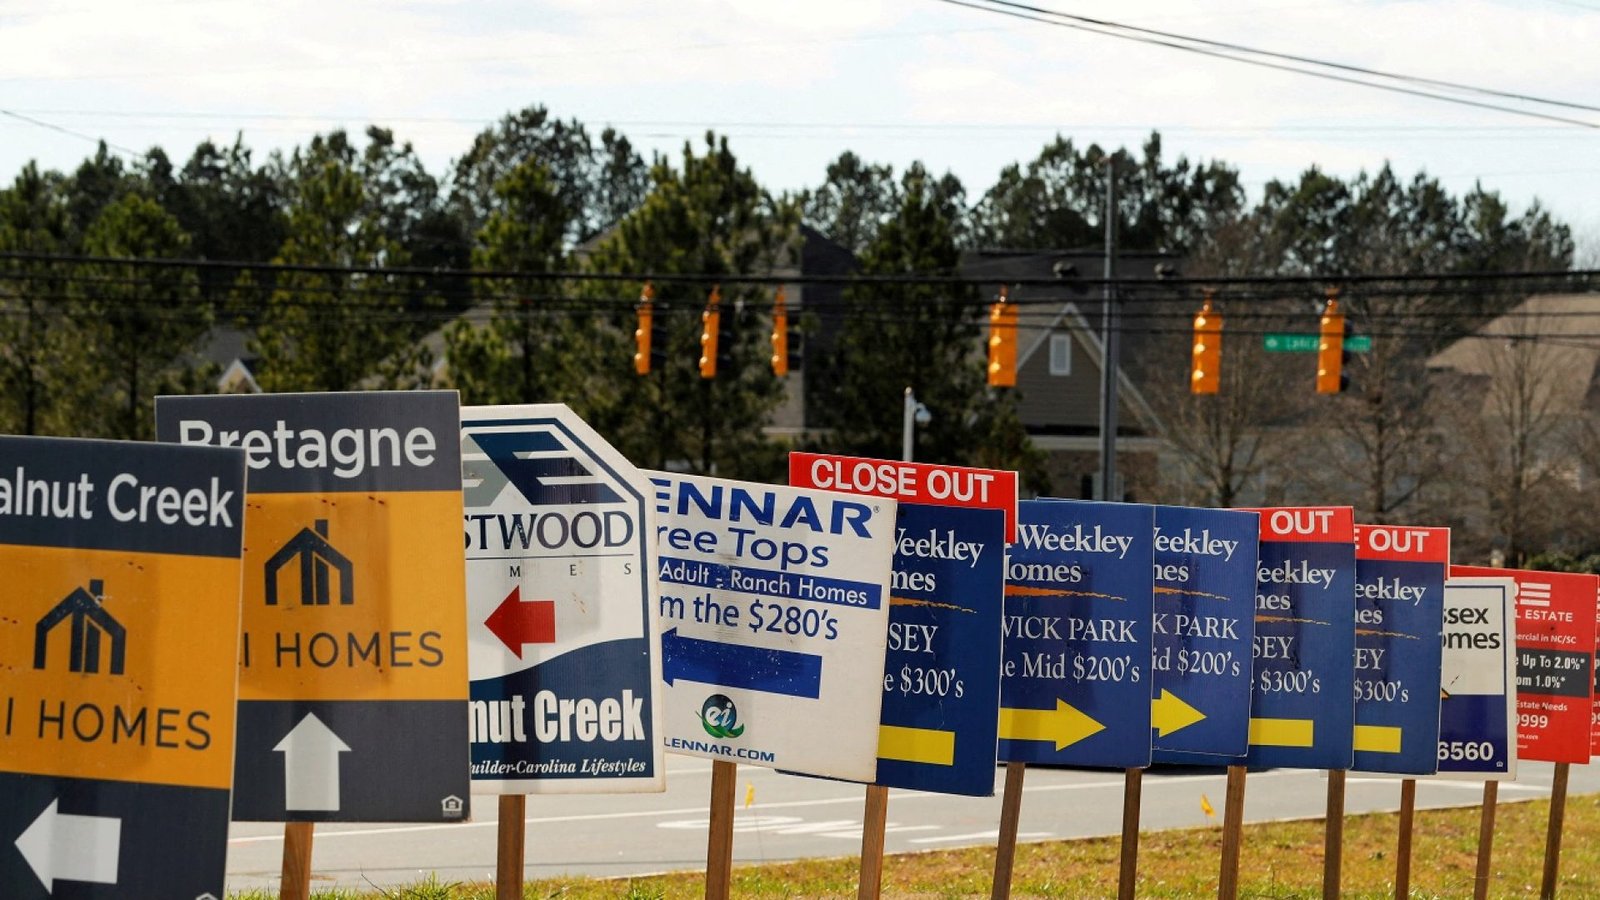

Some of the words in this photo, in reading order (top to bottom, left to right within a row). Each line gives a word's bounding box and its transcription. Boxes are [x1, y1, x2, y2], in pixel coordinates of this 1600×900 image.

[811, 459, 917, 496] CLOSE
[927, 469, 994, 503] OUT
[107, 473, 233, 528] Creek
[1270, 511, 1334, 535] OUT
[728, 527, 829, 570] Tops
[1018, 524, 1133, 560] Weekley
[1154, 527, 1239, 562] eekley
[1369, 529, 1430, 553] OUT
[659, 560, 709, 585] Adult
[731, 571, 790, 595] Ranch
[798, 578, 867, 605] Homes
[1257, 559, 1336, 590] eekley
[694, 593, 739, 628] the
[1525, 609, 1574, 623] ESTATE
[888, 621, 938, 654] SEY
[1068, 618, 1138, 643] PARK
[1174, 614, 1239, 640] PARK
[1441, 629, 1501, 650] mes
[1551, 634, 1577, 644] NC/SC
[275, 631, 444, 668] HOMES
[1177, 648, 1240, 676] $200's
[1522, 654, 1536, 669] Up
[1540, 655, 1551, 668] To
[900, 663, 964, 698] $300's
[1022, 651, 1066, 680] Mid
[1073, 652, 1140, 683] $200's
[1260, 667, 1320, 695] $300's
[38, 699, 211, 750] HOMES
[534, 689, 646, 743] Creek
[664, 736, 775, 762] LENNAR.COM
[1438, 741, 1494, 761] 6560
[470, 760, 576, 775] uilder-Carolina
[580, 757, 646, 777] Lifestyles
